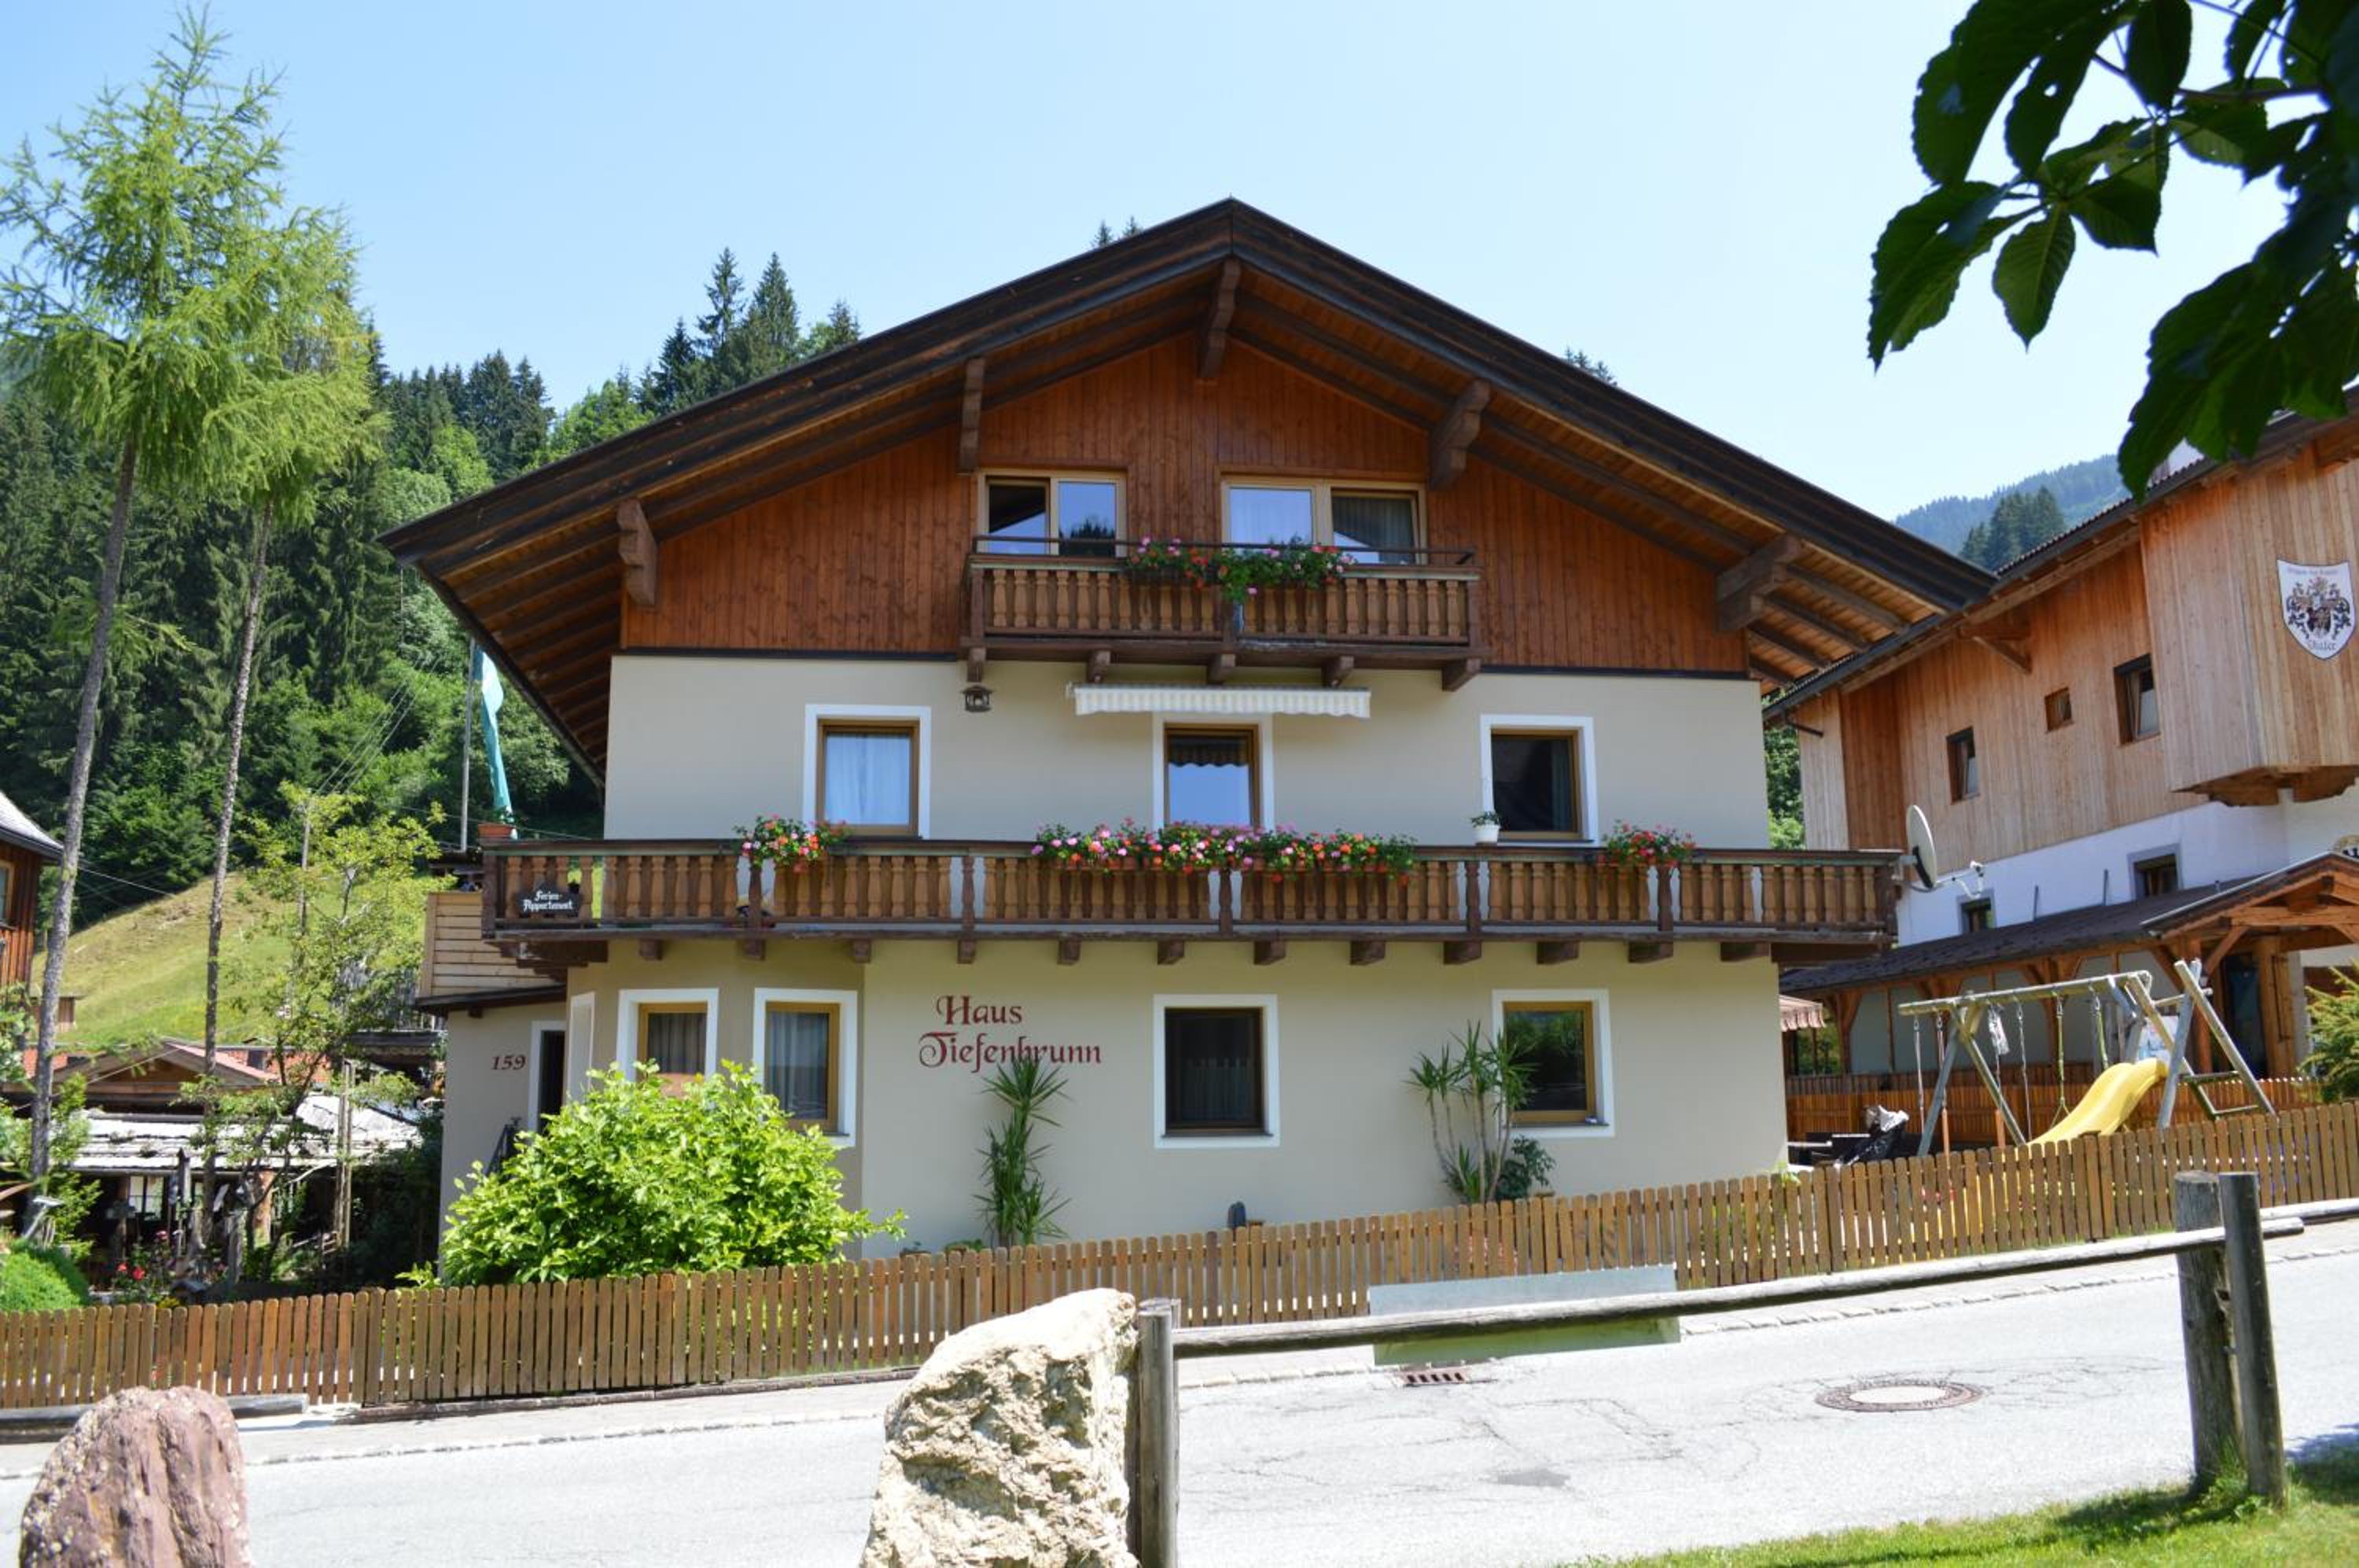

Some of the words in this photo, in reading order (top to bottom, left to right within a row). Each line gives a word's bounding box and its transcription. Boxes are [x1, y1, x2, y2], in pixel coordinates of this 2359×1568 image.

[936, 995, 1024, 1025] Haus
[491, 1055, 526, 1070] 159
[918, 1032, 1102, 1073] Tiefenbrunn
